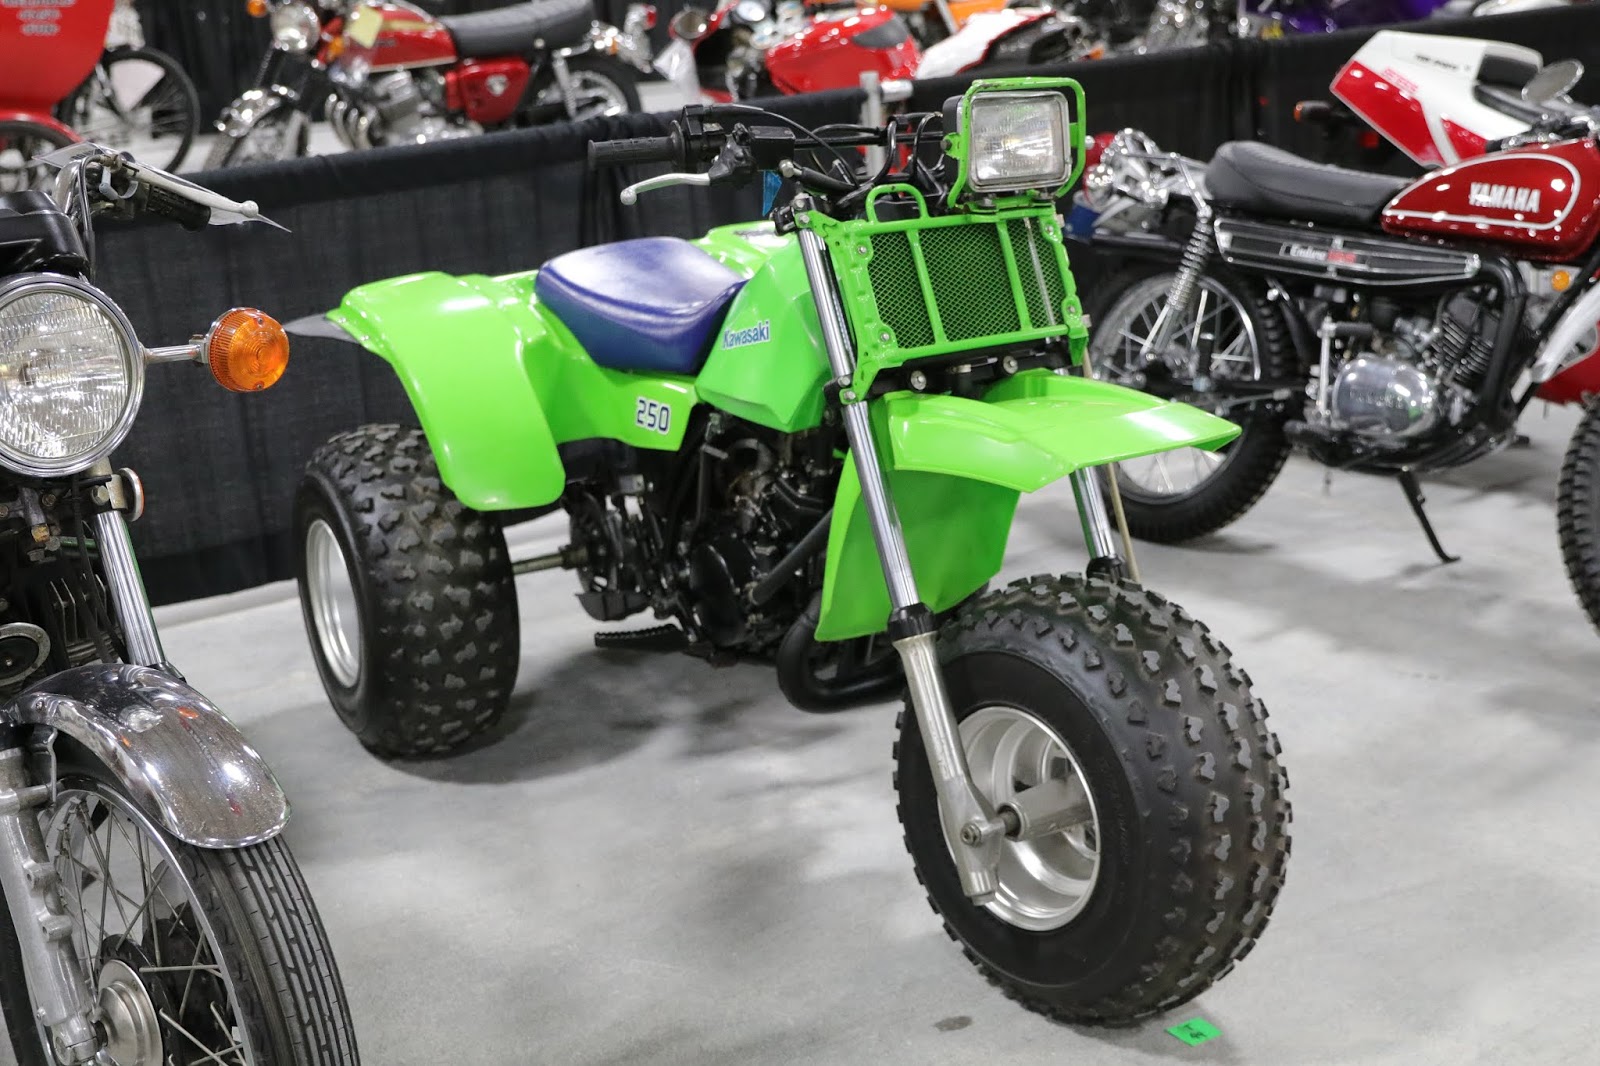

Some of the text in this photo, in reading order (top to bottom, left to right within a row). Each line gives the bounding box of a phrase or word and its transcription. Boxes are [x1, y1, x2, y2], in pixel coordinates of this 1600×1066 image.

[1469, 182, 1541, 214] YAMAHA
[723, 320, 770, 349] Kawasaki
[636, 397, 671, 434] 250
